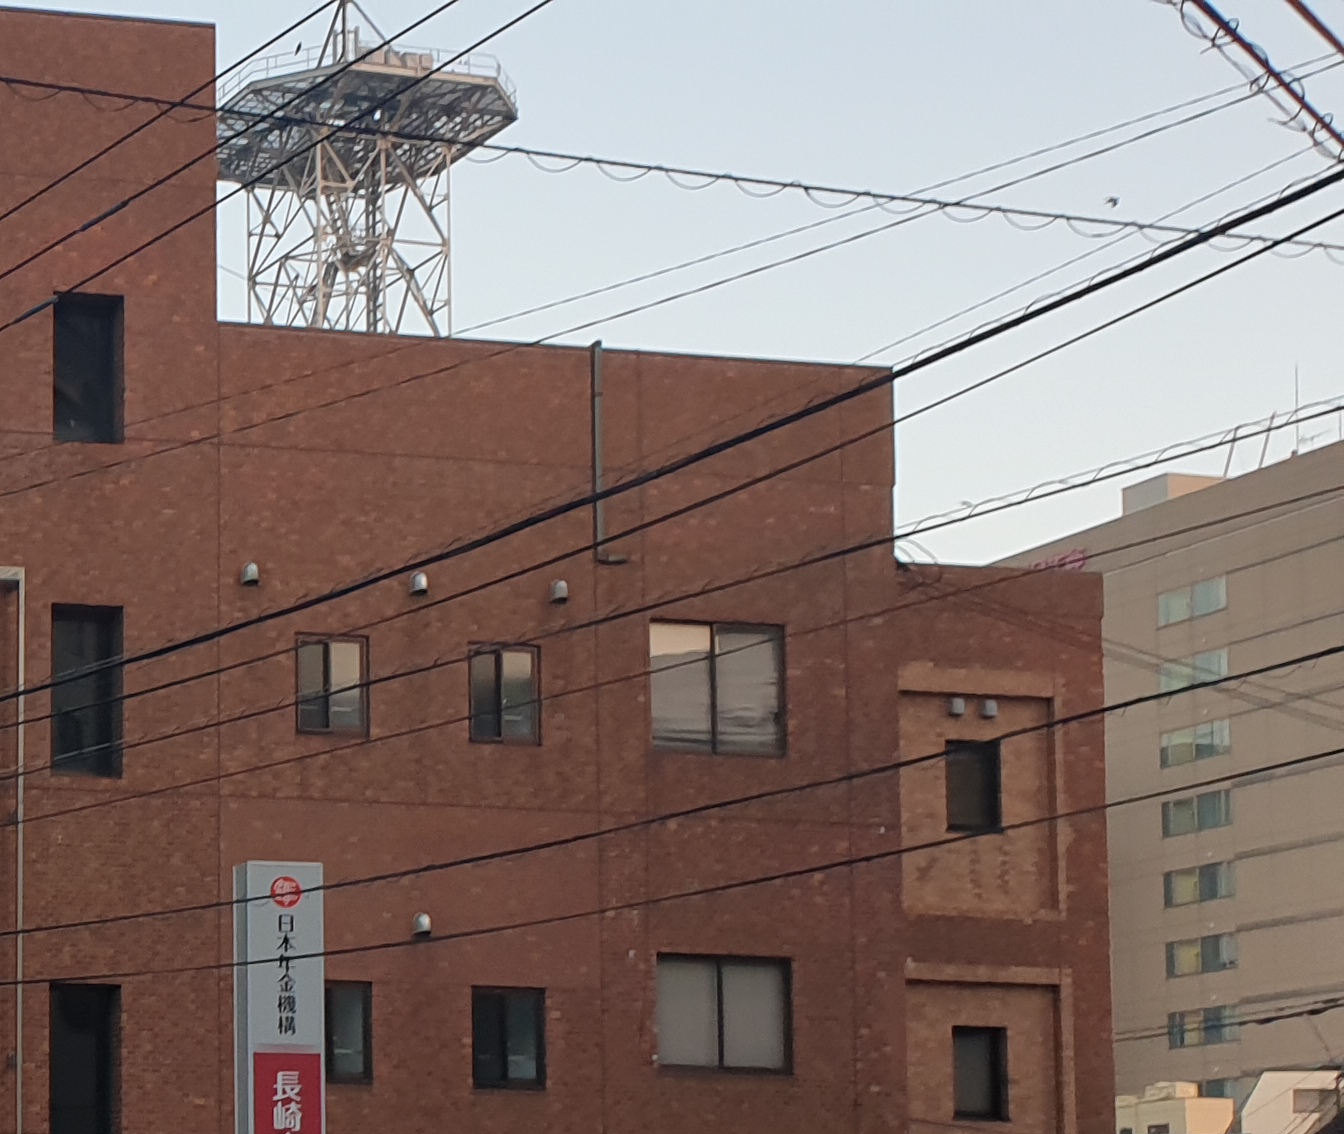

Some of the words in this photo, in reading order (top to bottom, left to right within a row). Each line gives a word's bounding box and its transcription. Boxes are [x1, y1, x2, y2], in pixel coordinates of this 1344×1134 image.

[276, 913, 297, 1036] 日本年金機構
